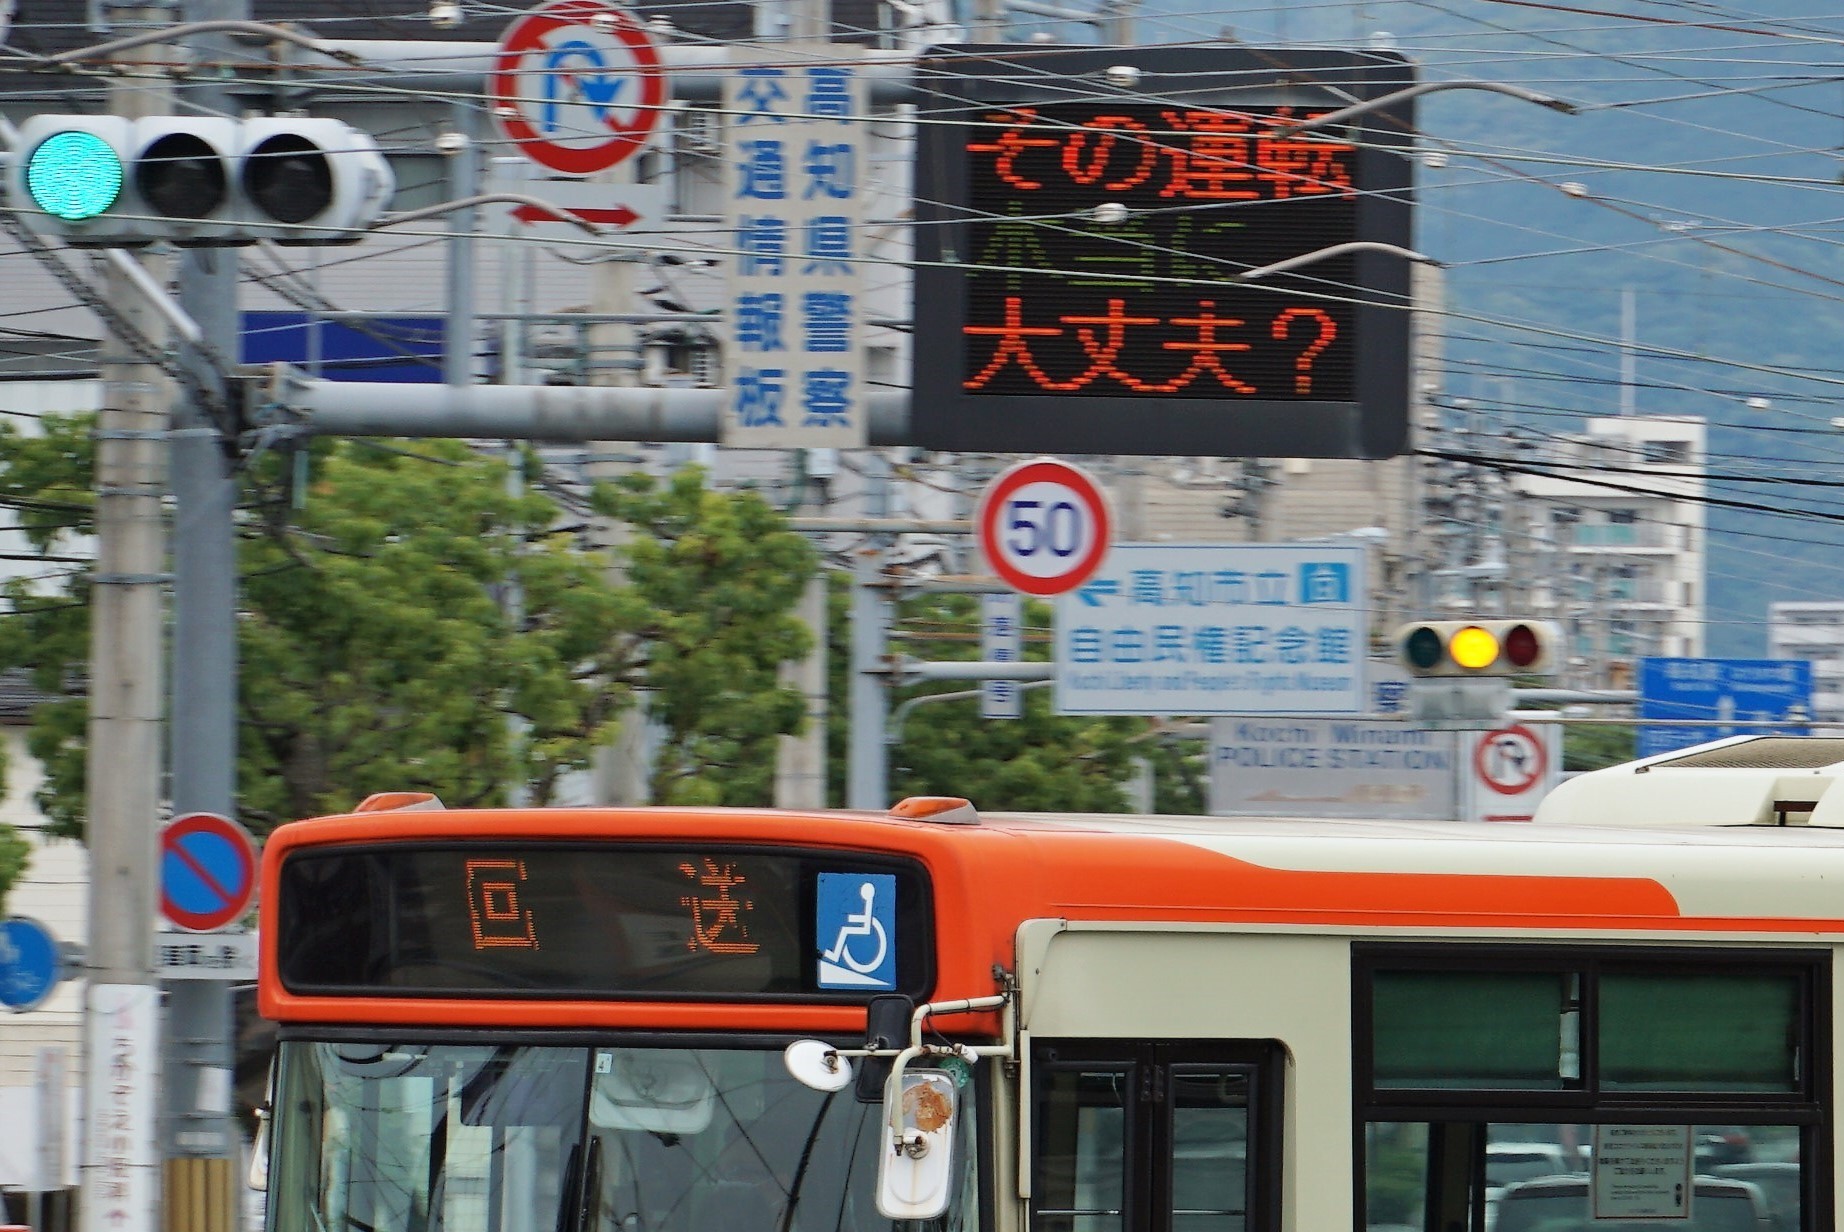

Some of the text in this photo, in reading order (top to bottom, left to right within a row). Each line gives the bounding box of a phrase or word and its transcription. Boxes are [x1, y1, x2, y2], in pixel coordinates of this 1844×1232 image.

[967, 107, 1356, 198] その運転
[736, 67, 788, 428] 交通情報板
[803, 67, 855, 428] 高知県警察
[964, 297, 1338, 393] 大丈夫？
[1006, 500, 1082, 557] 50
[1130, 569, 1290, 607] 高知市立
[1070, 624, 1352, 664] 自由民権記念館
[1219, 746, 1323, 768] POLICE
